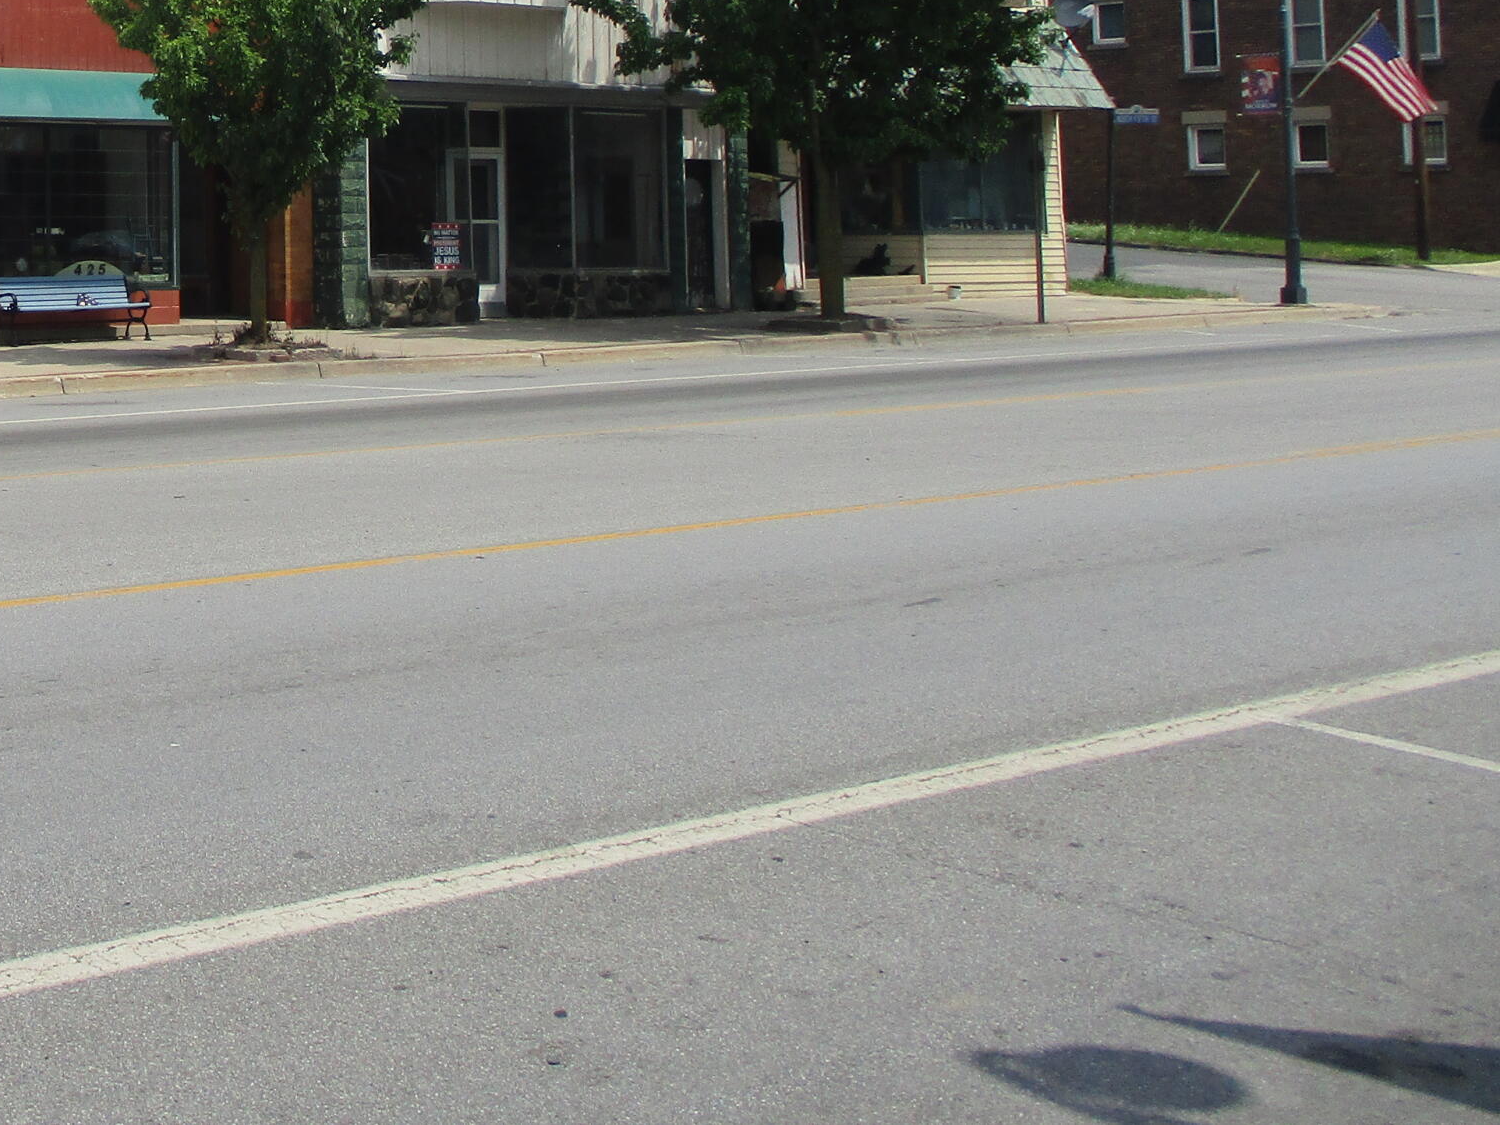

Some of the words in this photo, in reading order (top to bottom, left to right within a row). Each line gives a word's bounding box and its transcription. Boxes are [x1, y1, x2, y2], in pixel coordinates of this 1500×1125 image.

[434, 246, 459, 255] JESUS
[434, 256, 442, 264] IS
[443, 256, 460, 264] KING
[74, 264, 106, 276] 425
